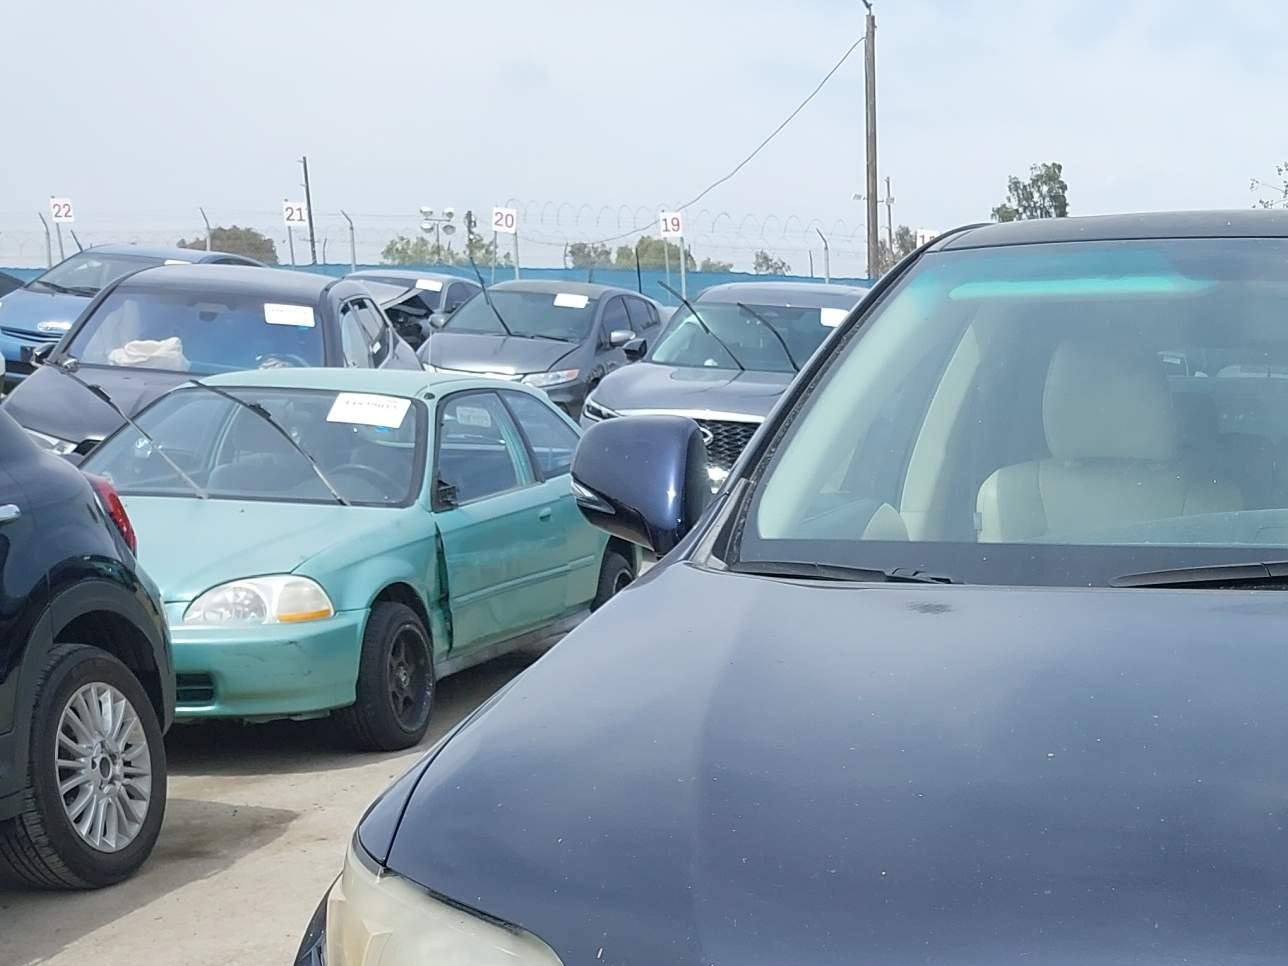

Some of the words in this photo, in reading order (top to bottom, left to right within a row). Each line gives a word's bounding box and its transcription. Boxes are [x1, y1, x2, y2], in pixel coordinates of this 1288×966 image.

[52, 203, 73, 218] 22
[285, 206, 306, 222] 21
[494, 211, 515, 228] 20
[662, 217, 680, 232] 19
